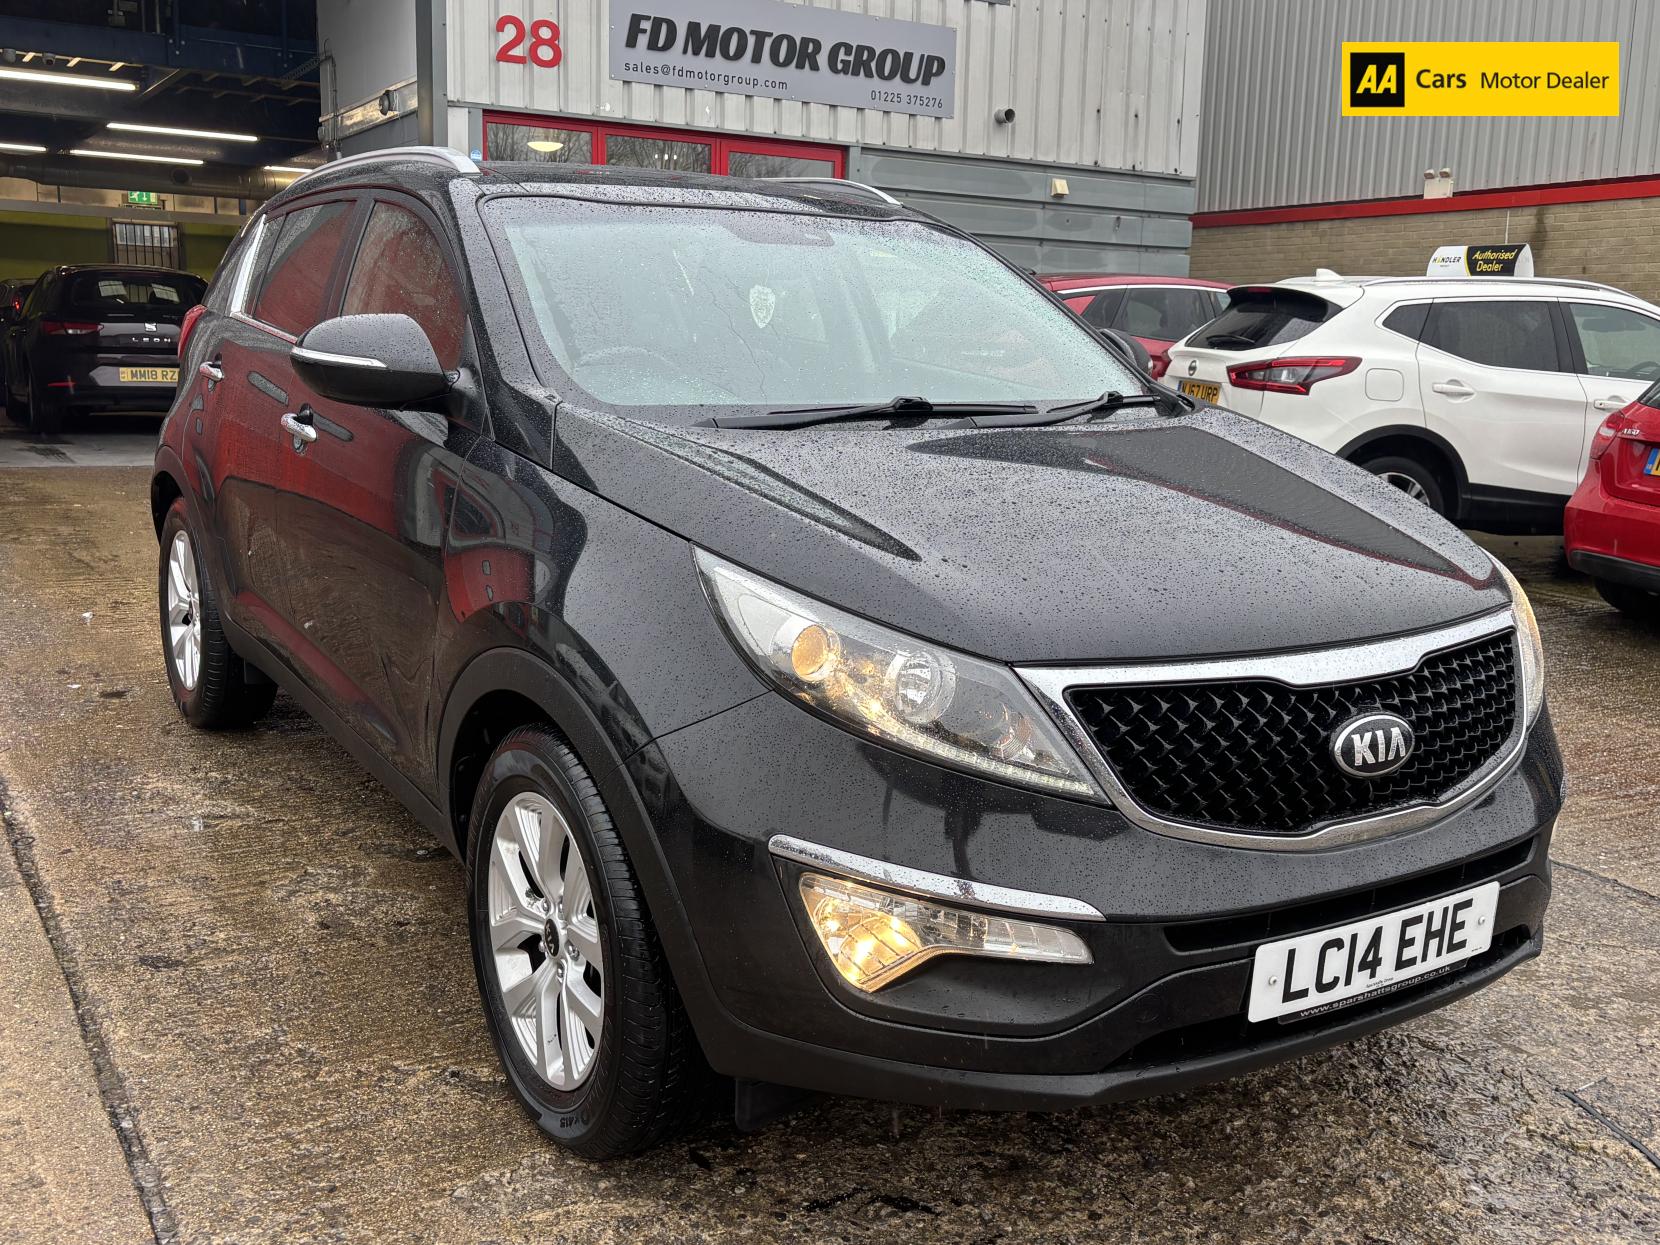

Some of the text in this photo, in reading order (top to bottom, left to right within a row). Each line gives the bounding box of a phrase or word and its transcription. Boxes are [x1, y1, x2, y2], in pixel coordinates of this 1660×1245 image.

[496, 15, 562, 68] 28
[625, 13, 945, 86] FD MOTOR GROUP
[624, 61, 788, 90] sales@fdmotorgroup.com
[870, 90, 943, 109] 01225 375276
[1472, 249, 1518, 260] Authorised
[1476, 261, 1503, 272] Dealer
[130, 369, 158, 380] MM18
[1351, 727, 1406, 766] KIA
[1282, 898, 1473, 1003] LC14 EHE
[1300, 966, 1451, 1018] www.sparshattsgroup.co.uk
